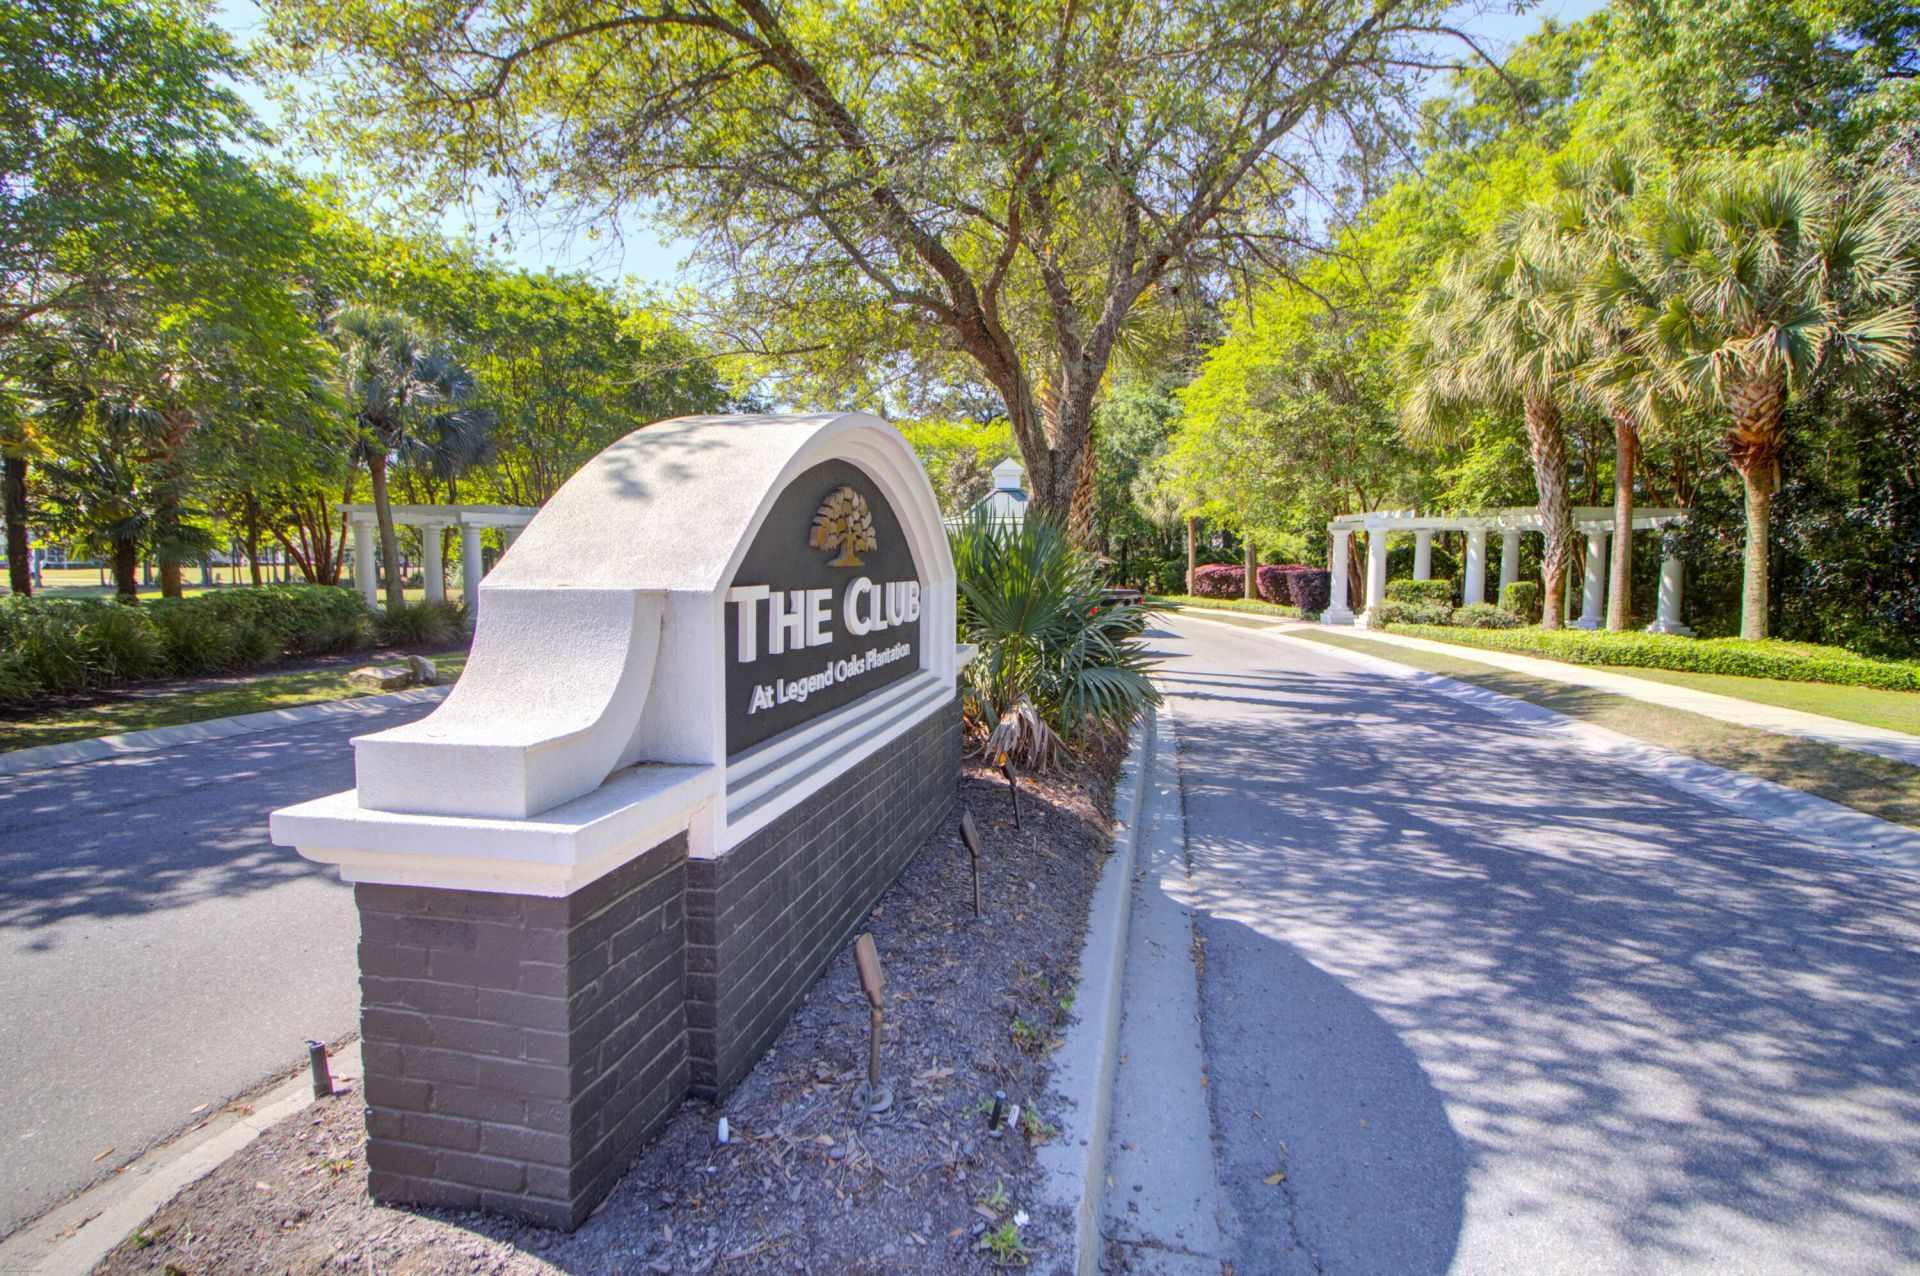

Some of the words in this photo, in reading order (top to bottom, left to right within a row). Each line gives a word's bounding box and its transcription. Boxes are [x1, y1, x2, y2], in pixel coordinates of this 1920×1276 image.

[725, 584, 832, 663] THE
[843, 576, 920, 636] CLUB
[747, 684, 775, 715] At
[776, 661, 834, 703] Legend
[834, 654, 866, 682] Oaks
[865, 643, 911, 671] Plantation
